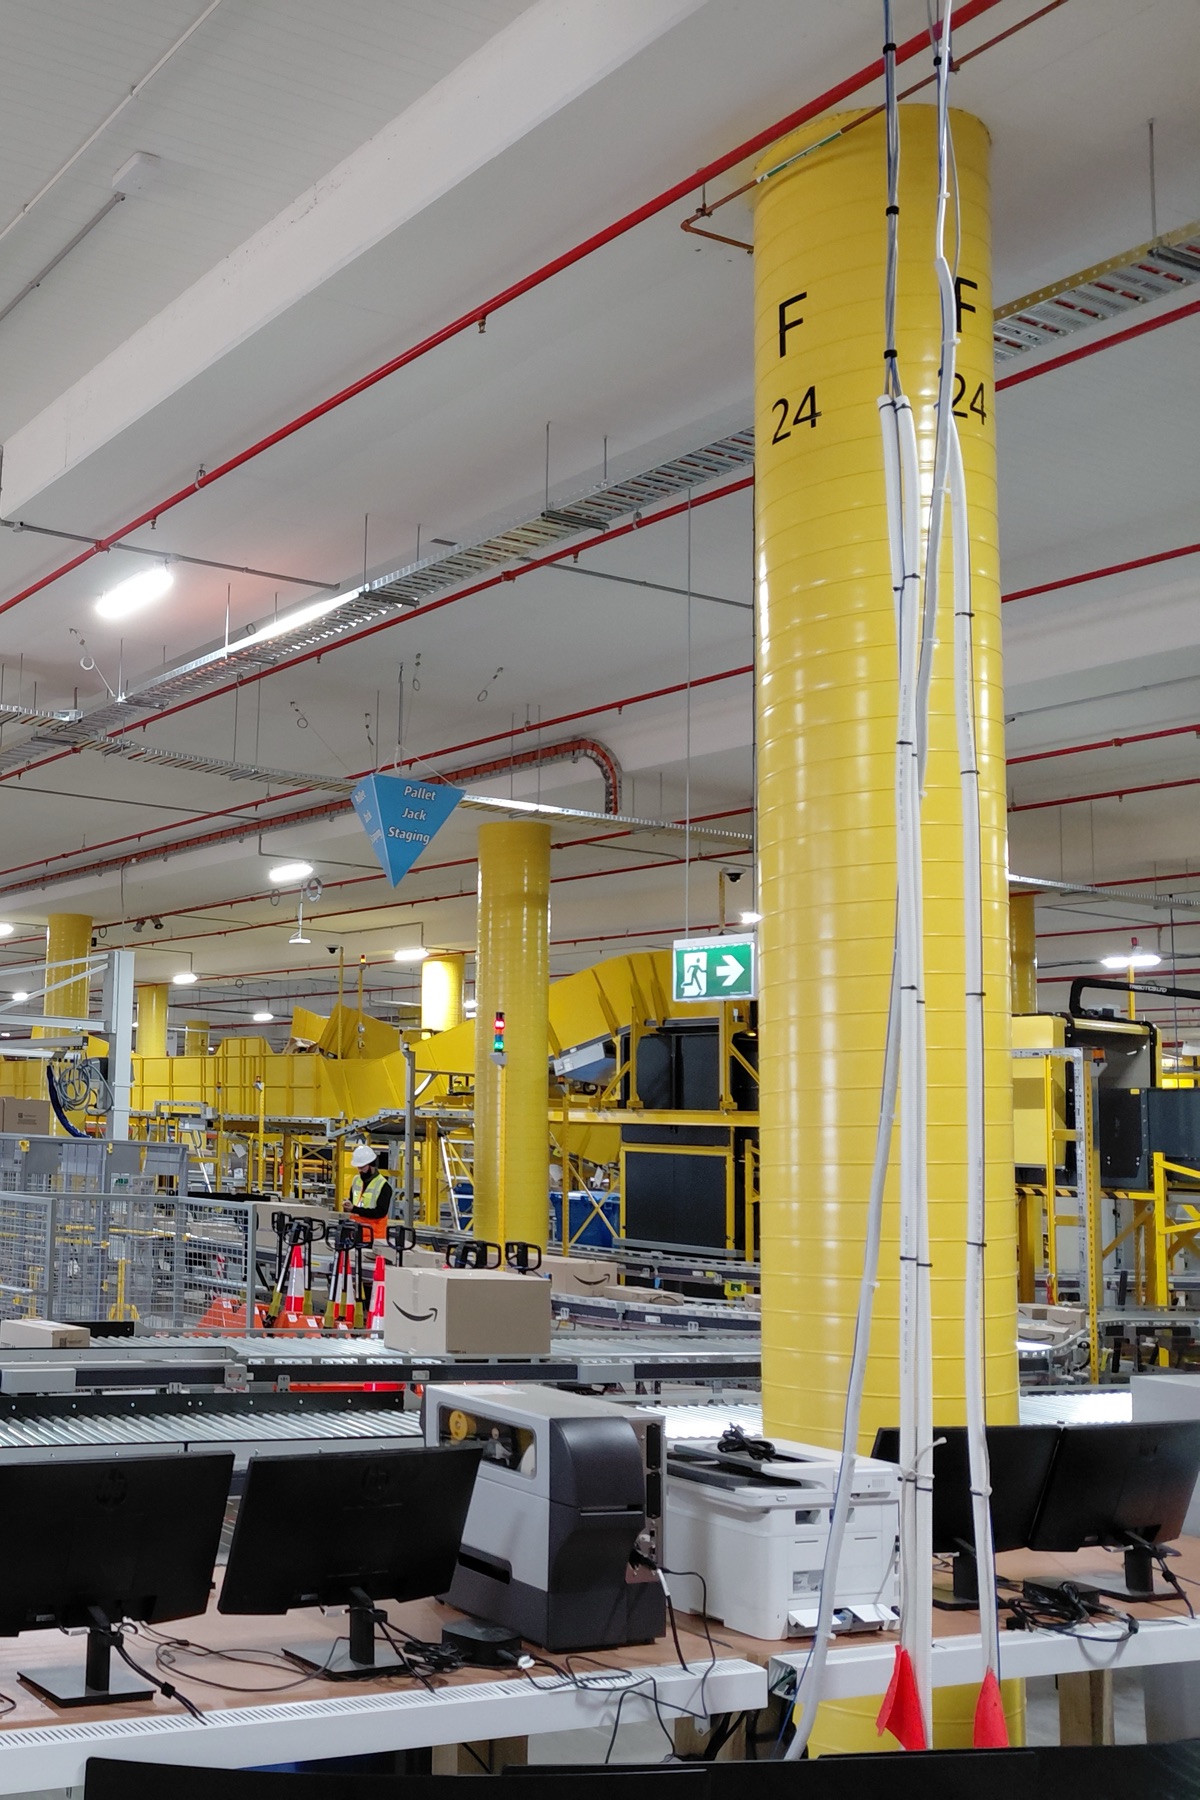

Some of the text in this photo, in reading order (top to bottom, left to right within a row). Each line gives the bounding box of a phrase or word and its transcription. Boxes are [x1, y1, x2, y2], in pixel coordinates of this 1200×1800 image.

[778, 291, 807, 358] F
[954, 276, 978, 333] F
[771, 385, 822, 445] 24
[938, 369, 987, 426] 24
[401, 808, 426, 821] Jack
[404, 785, 436, 801] Pallet
[387, 826, 430, 846] Staging
